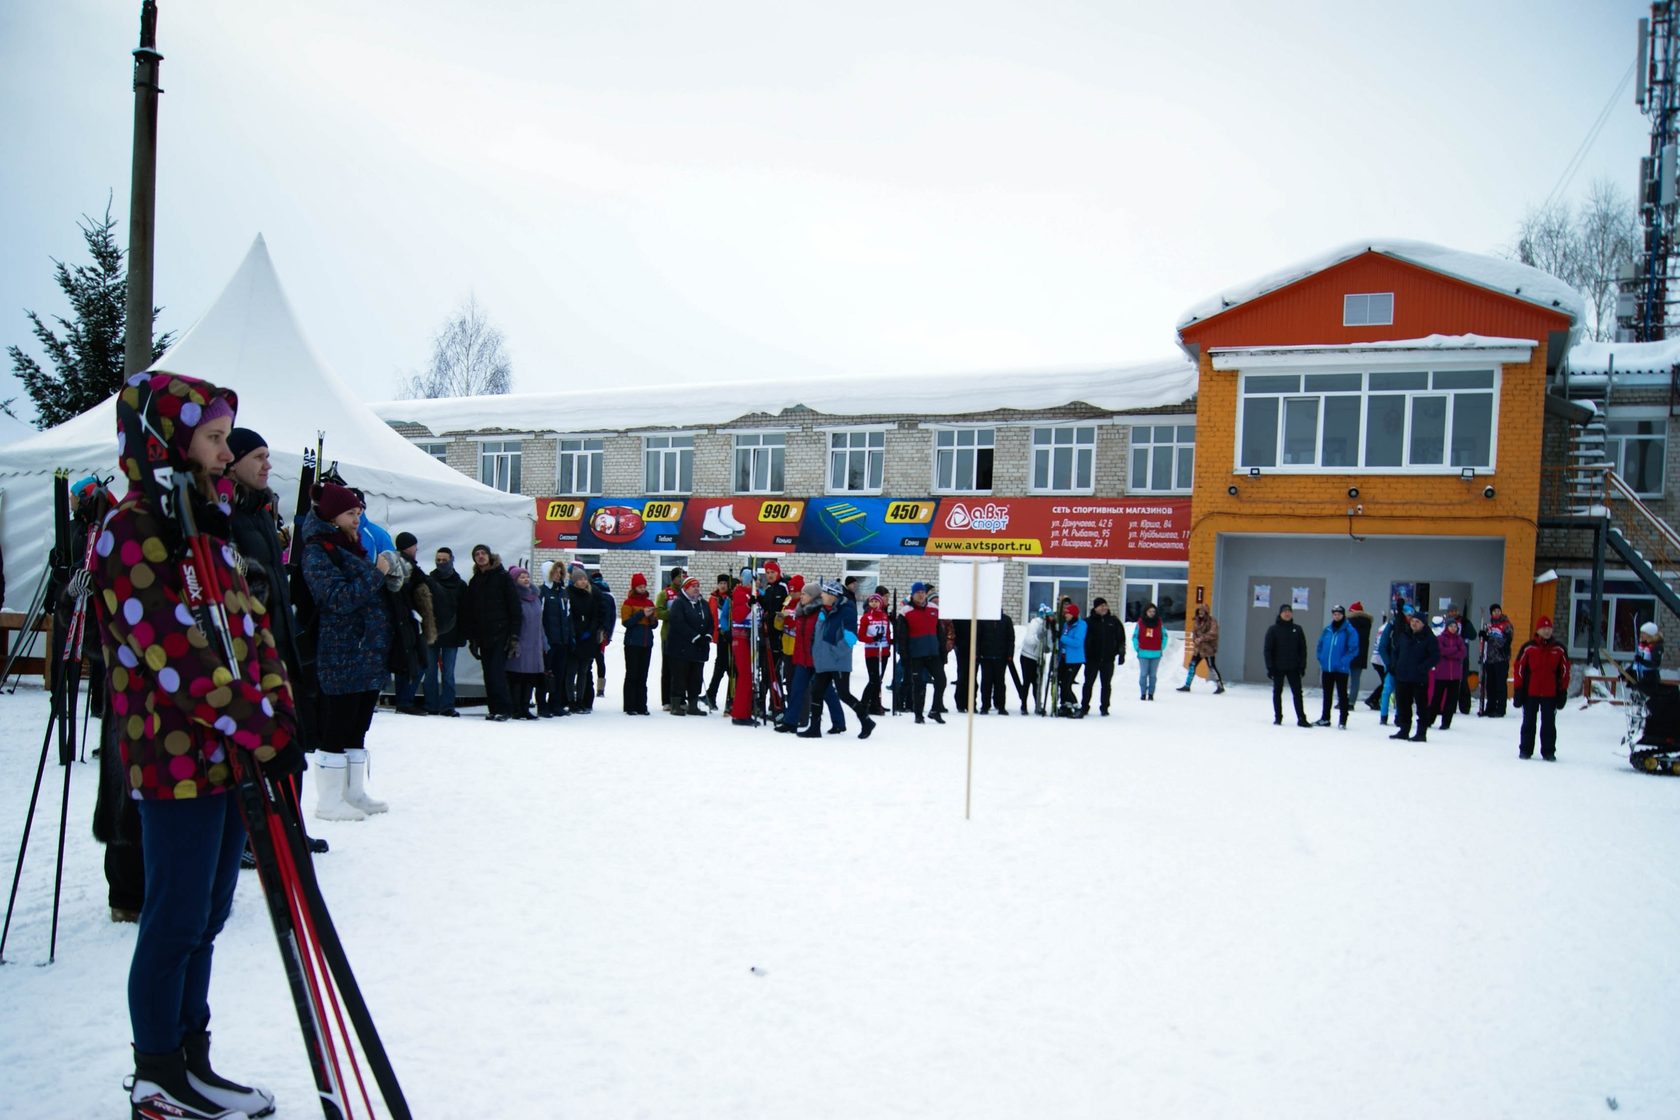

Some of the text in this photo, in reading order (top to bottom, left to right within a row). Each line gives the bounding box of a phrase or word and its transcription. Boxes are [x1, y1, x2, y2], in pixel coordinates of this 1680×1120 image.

[1052, 506, 1173, 515] СЕТЬ СПОРТИВНЫХ МАГАЗИНОВ
[971, 518, 1009, 533] спорт
[1051, 520, 1060, 528] ул.
[1128, 521, 1138, 529] ул.
[1050, 530, 1060, 538] ул.
[1128, 531, 1138, 540] ул.
[934, 539, 1032, 552] www.avtsport.ru
[1050, 540, 1059, 549] ул.
